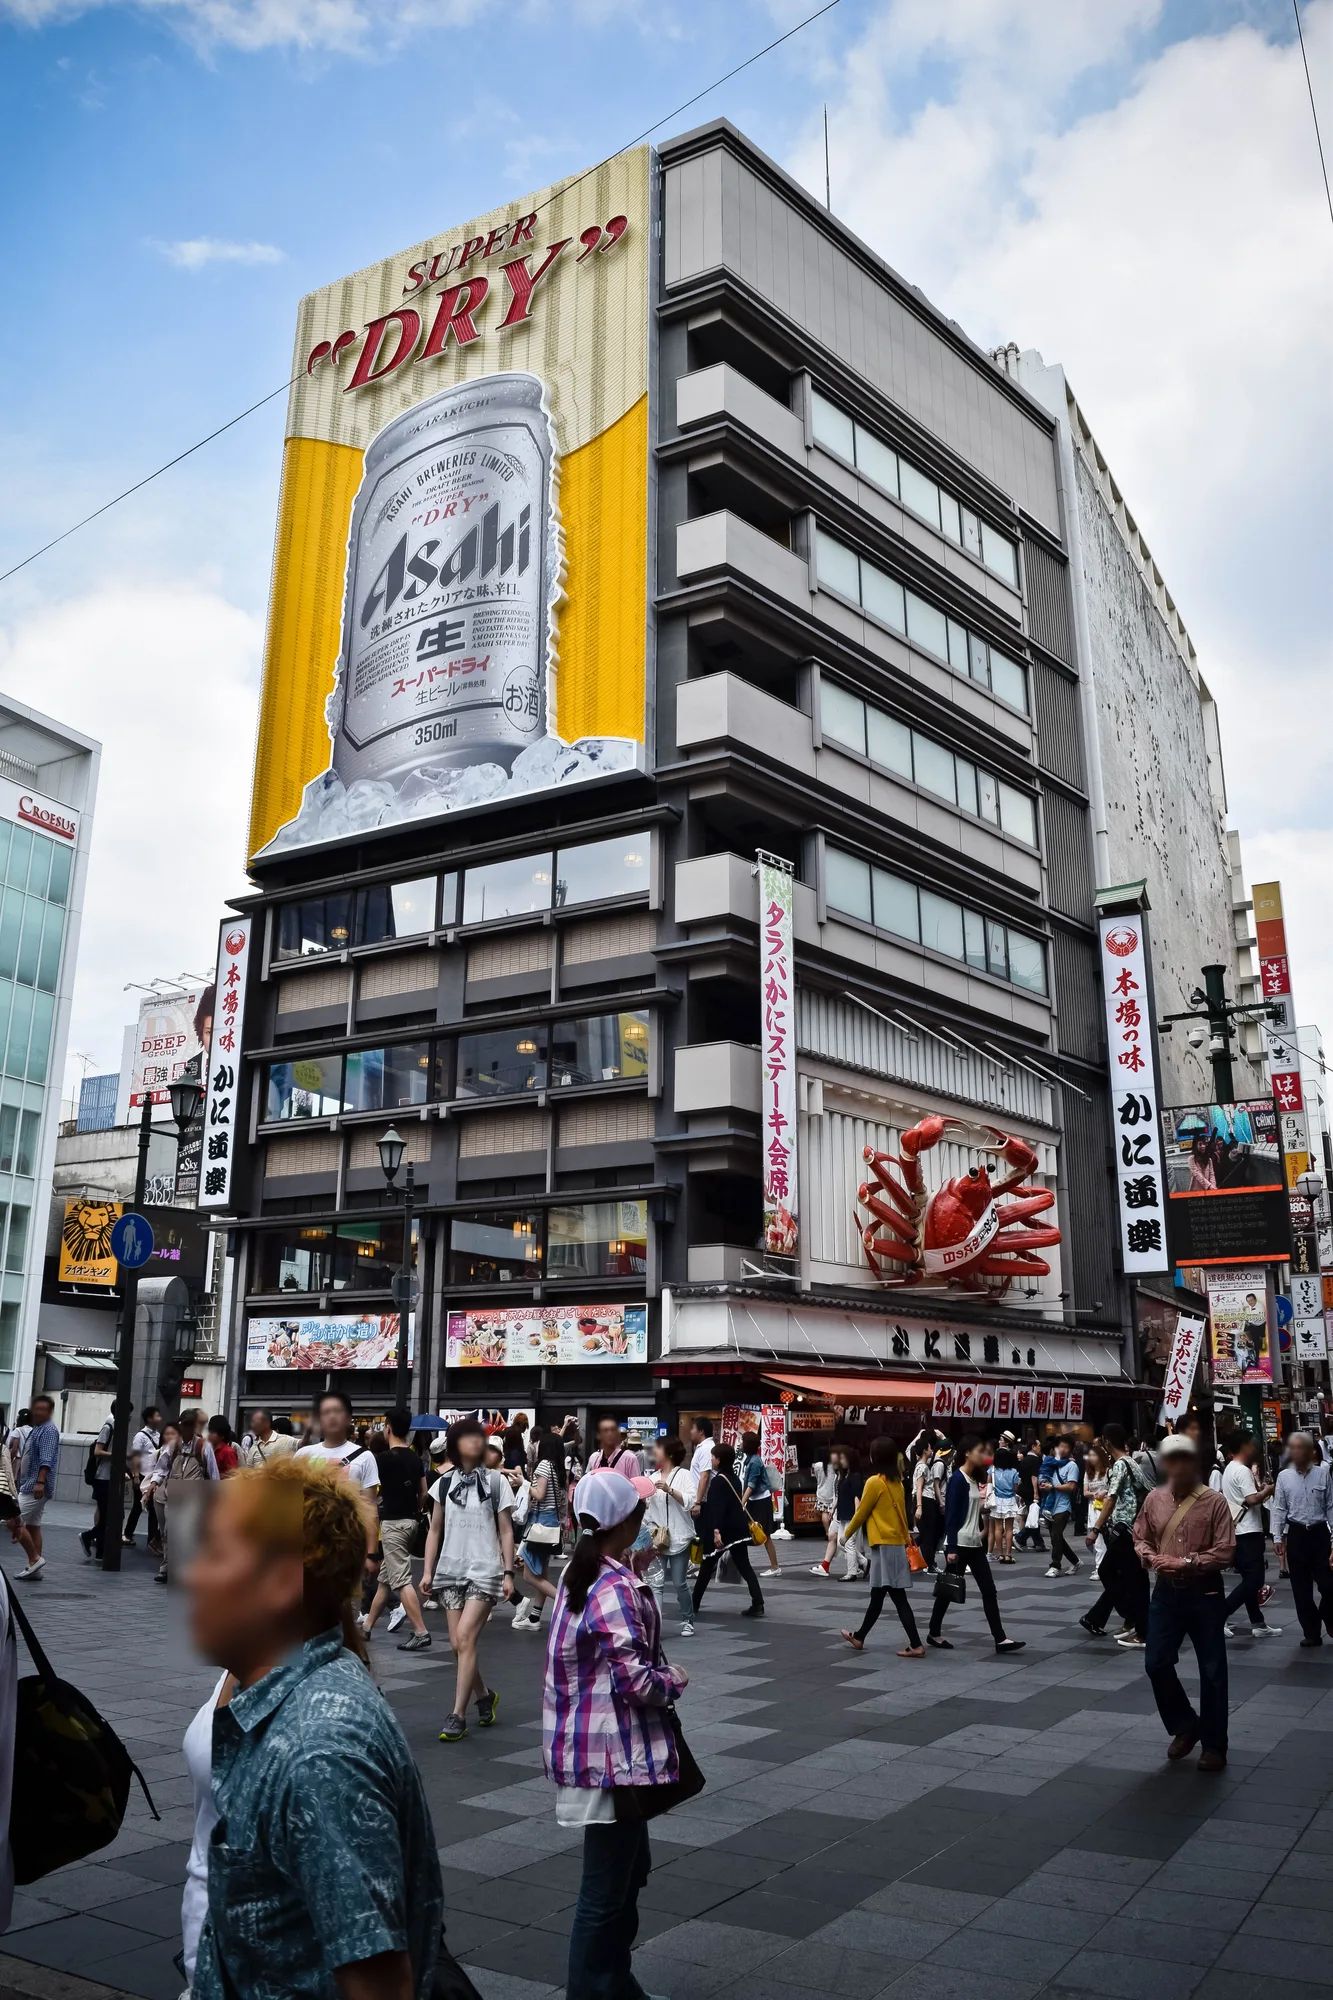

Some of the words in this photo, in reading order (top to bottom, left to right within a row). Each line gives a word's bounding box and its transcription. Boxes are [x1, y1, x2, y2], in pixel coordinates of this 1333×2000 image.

[402, 212, 538, 296] SUPER
[386, 487, 413, 523] ASAHI
[416, 451, 477, 486] BREWERIES
[480, 452, 515, 483] LIMITED
[425, 480, 452, 495] DRAFT
[451, 473, 473, 485] BEER
[437, 468, 462, 482] ASAHI
[433, 490, 464, 507] SUPER
[360, 500, 531, 629] Asahi
[416, 620, 466, 662] 生
[471, 640, 494, 649] ASAHI
[391, 655, 491, 697] スーパードライ
[505, 684, 539, 718] お酒
[415, 718, 458, 746] 350ml
[219, 962, 241, 1053] 本場の味
[1111, 967, 1146, 1073] 本場の味
[141, 1035, 187, 1053] DEEP
[147, 1048, 178, 1058] Group
[765, 901, 791, 1199] タラバかにステーキ会席
[1285, 1116, 1304, 1150] 白木屋
[65, 1264, 112, 1276] ライオンキング
[1165, 1328, 1195, 1408] 活かに入荷
[935, 1384, 1083, 1416] かにの日特別販売
